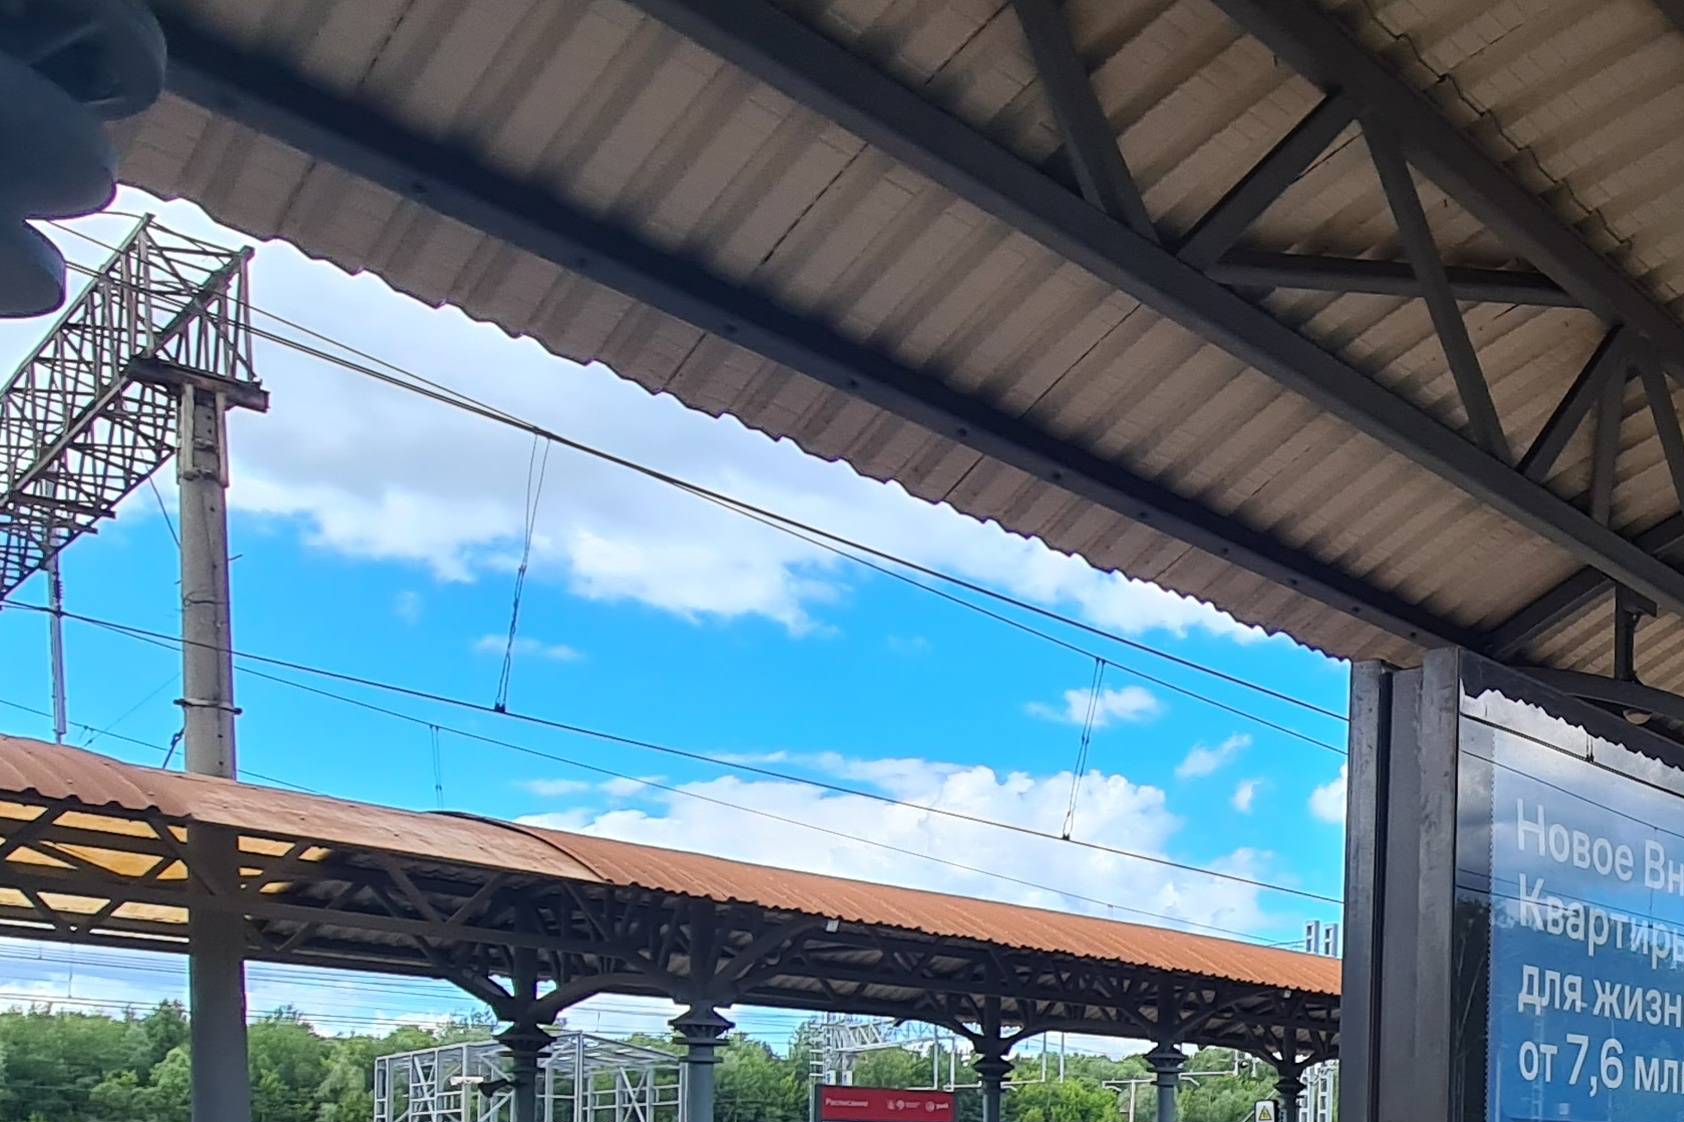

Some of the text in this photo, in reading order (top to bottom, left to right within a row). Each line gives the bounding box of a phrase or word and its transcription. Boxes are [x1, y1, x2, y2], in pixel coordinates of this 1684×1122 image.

[1516, 799, 1635, 881] Новое
[1517, 964, 1584, 1016] для
[1518, 1040, 1558, 1082] от
[1565, 1033, 1624, 1097] 7,6
